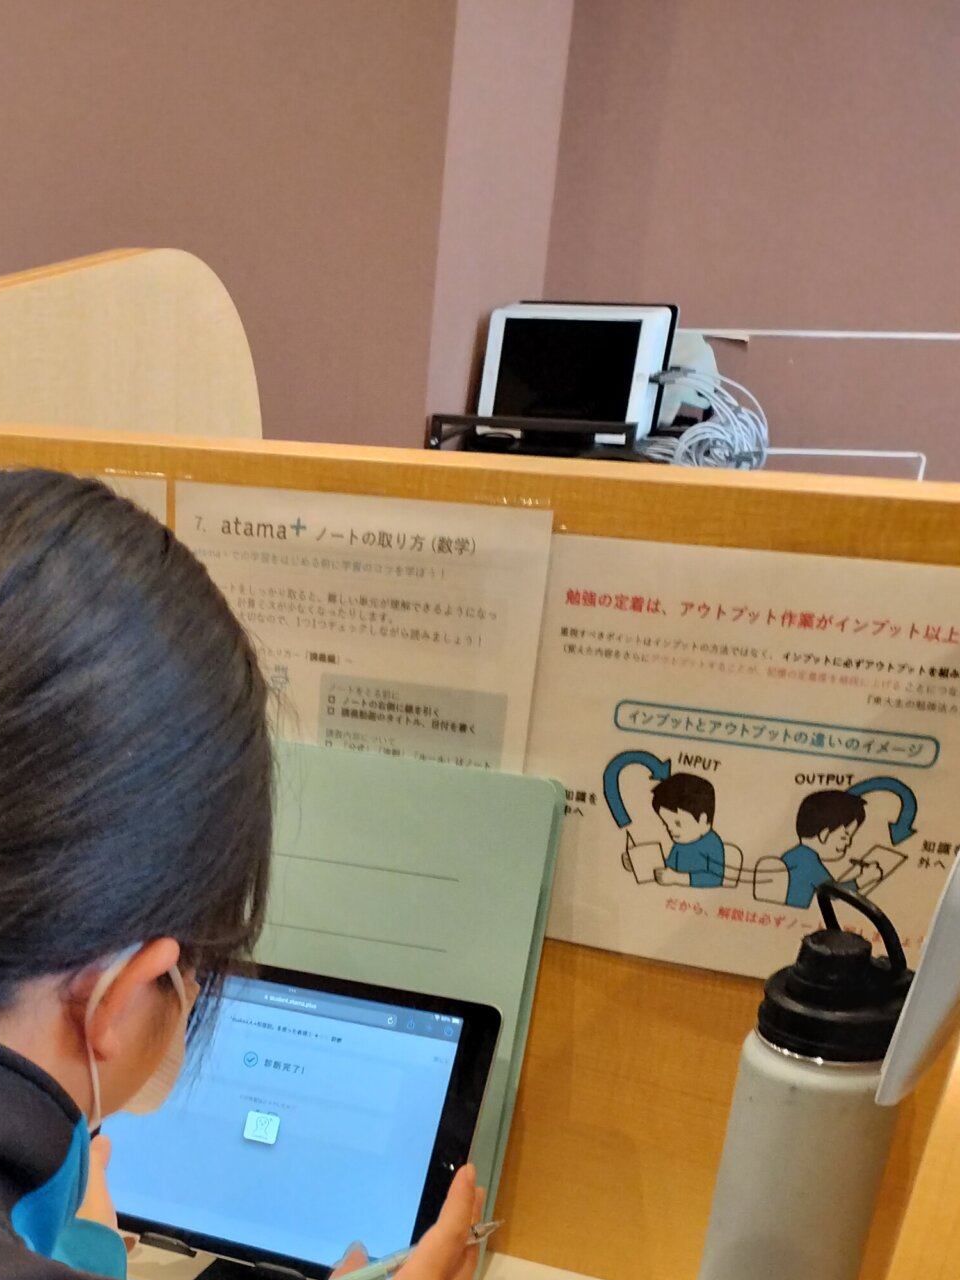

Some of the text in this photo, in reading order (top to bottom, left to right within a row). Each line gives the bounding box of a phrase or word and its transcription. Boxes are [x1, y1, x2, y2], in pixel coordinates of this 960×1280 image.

[221, 517, 307, 540] atama+
[677, 751, 722, 772] INPUT
[795, 772, 855, 787] OUTPUT
